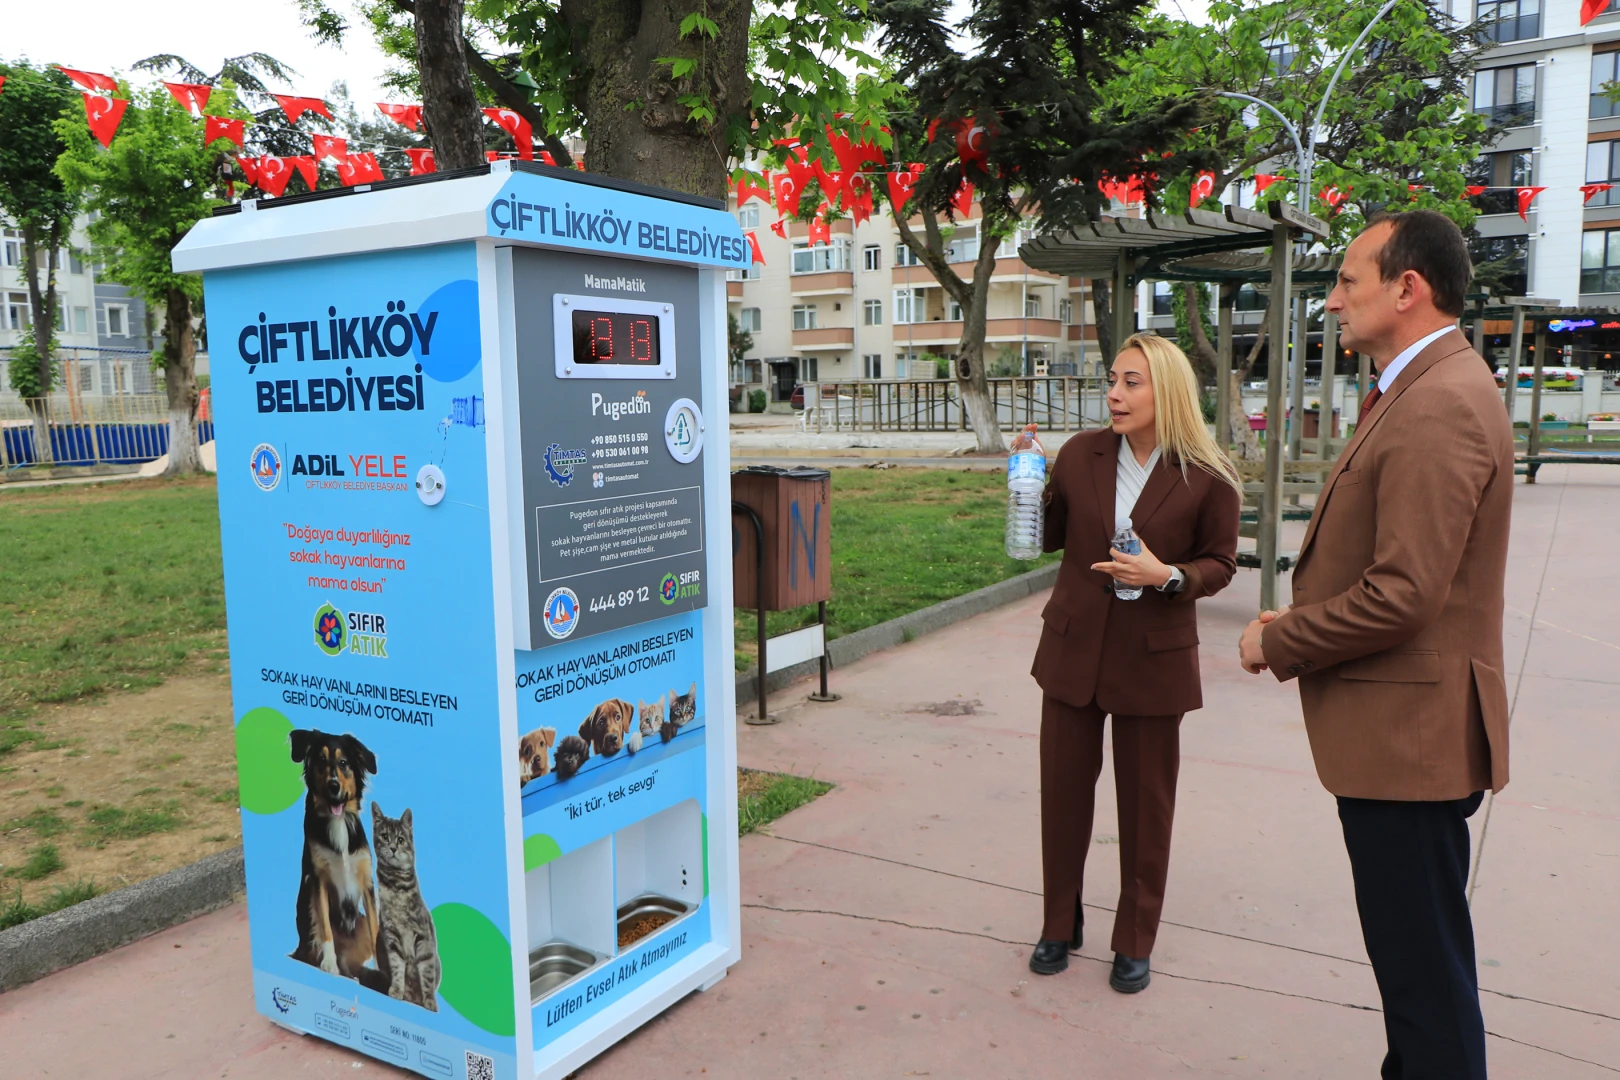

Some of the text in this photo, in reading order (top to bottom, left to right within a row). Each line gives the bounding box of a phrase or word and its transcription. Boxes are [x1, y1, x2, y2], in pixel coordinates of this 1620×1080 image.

[490, 193, 747, 263] ÇİFTLİKKÖY BELEDİYESİ
[584, 273, 646, 293] MamaMatik
[238, 300, 439, 374] ÇİFTLİKKÖY
[255, 363, 425, 413] BELEDİYESİ
[591, 432, 648, 445] +90 850 515 0 550
[591, 445, 649, 458] +90 530 061 00 98
[348, 455, 408, 478] YELE
[570, 508, 599, 520] Pugedon
[612, 505, 624, 514] atık
[624, 502, 645, 514] projesi
[645, 497, 678, 511] kapsamında
[583, 511, 668, 531] geri dönüşümü destekleyerek
[551, 537, 571, 547] sokak
[571, 531, 610, 545] hayvanlarını
[611, 526, 637, 538] besleyen
[637, 524, 658, 534] çevreci
[658, 521, 666, 530] bir
[560, 549, 571, 558] Pet
[599, 541, 612, 552] şişe
[620, 537, 638, 547] metal
[638, 533, 659, 544] kutular
[289, 549, 406, 571] sokak hayvanlarına
[600, 546, 656, 562] mama vermektedir.
[308, 576, 348, 590] mama
[679, 570, 700, 585] SIFIR
[589, 586, 650, 613] 444 89 12
[680, 583, 701, 598] ATIK
[348, 612, 386, 634] SIFIR
[350, 635, 388, 658] ATIK
[557, 641, 640, 676] HAYVANLARINI
[642, 627, 694, 653] BESLEYEN
[534, 649, 676, 703] GERİ DÖNÜŞÜM OTOMATI
[261, 668, 458, 711] SOKAK HAYVANLARINI BESLEYEN
[282, 690, 434, 727] GERİ DÖNÜŞÜM OTOMATI
[584, 797, 606, 813] tür,
[607, 786, 626, 803] tek
[546, 931, 688, 1028] Lütfen Evsel Atık Atmayınız
